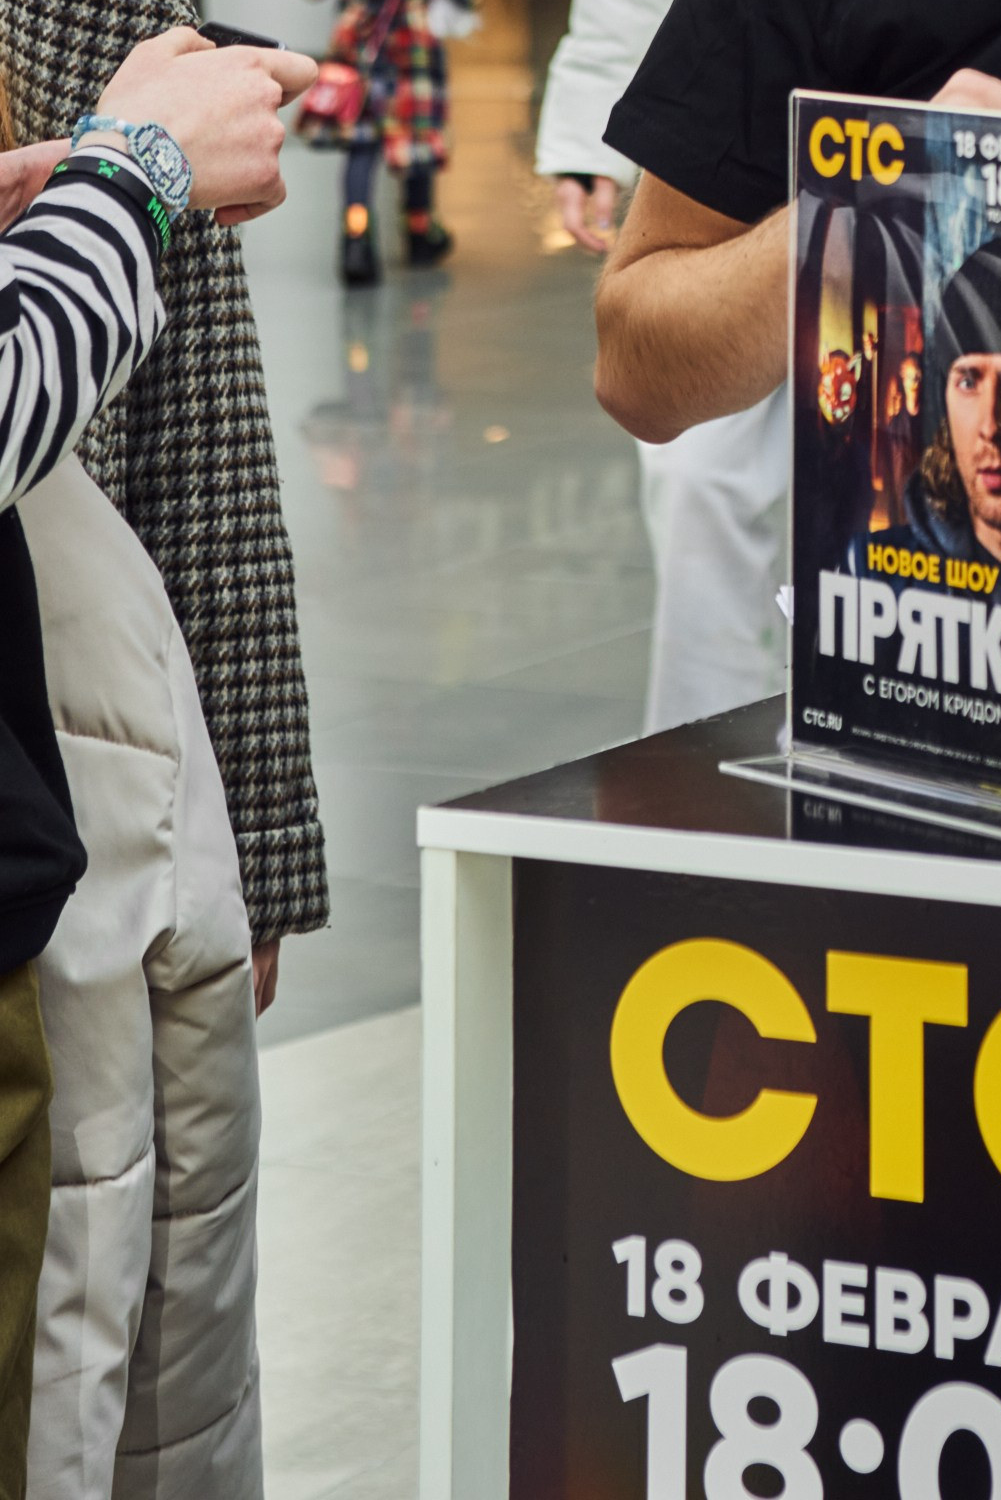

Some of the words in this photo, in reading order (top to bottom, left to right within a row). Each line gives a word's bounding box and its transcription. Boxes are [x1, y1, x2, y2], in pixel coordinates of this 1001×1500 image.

[808, 116, 905, 185] СТС
[953, 130, 976, 159] 18
[867, 544, 941, 583] НОВОЕ
[946, 559, 1000, 594] ШОУ
[863, 674, 876, 696] С
[879, 679, 940, 711] ЕГОРОМ
[611, 1235, 705, 1325] 18
